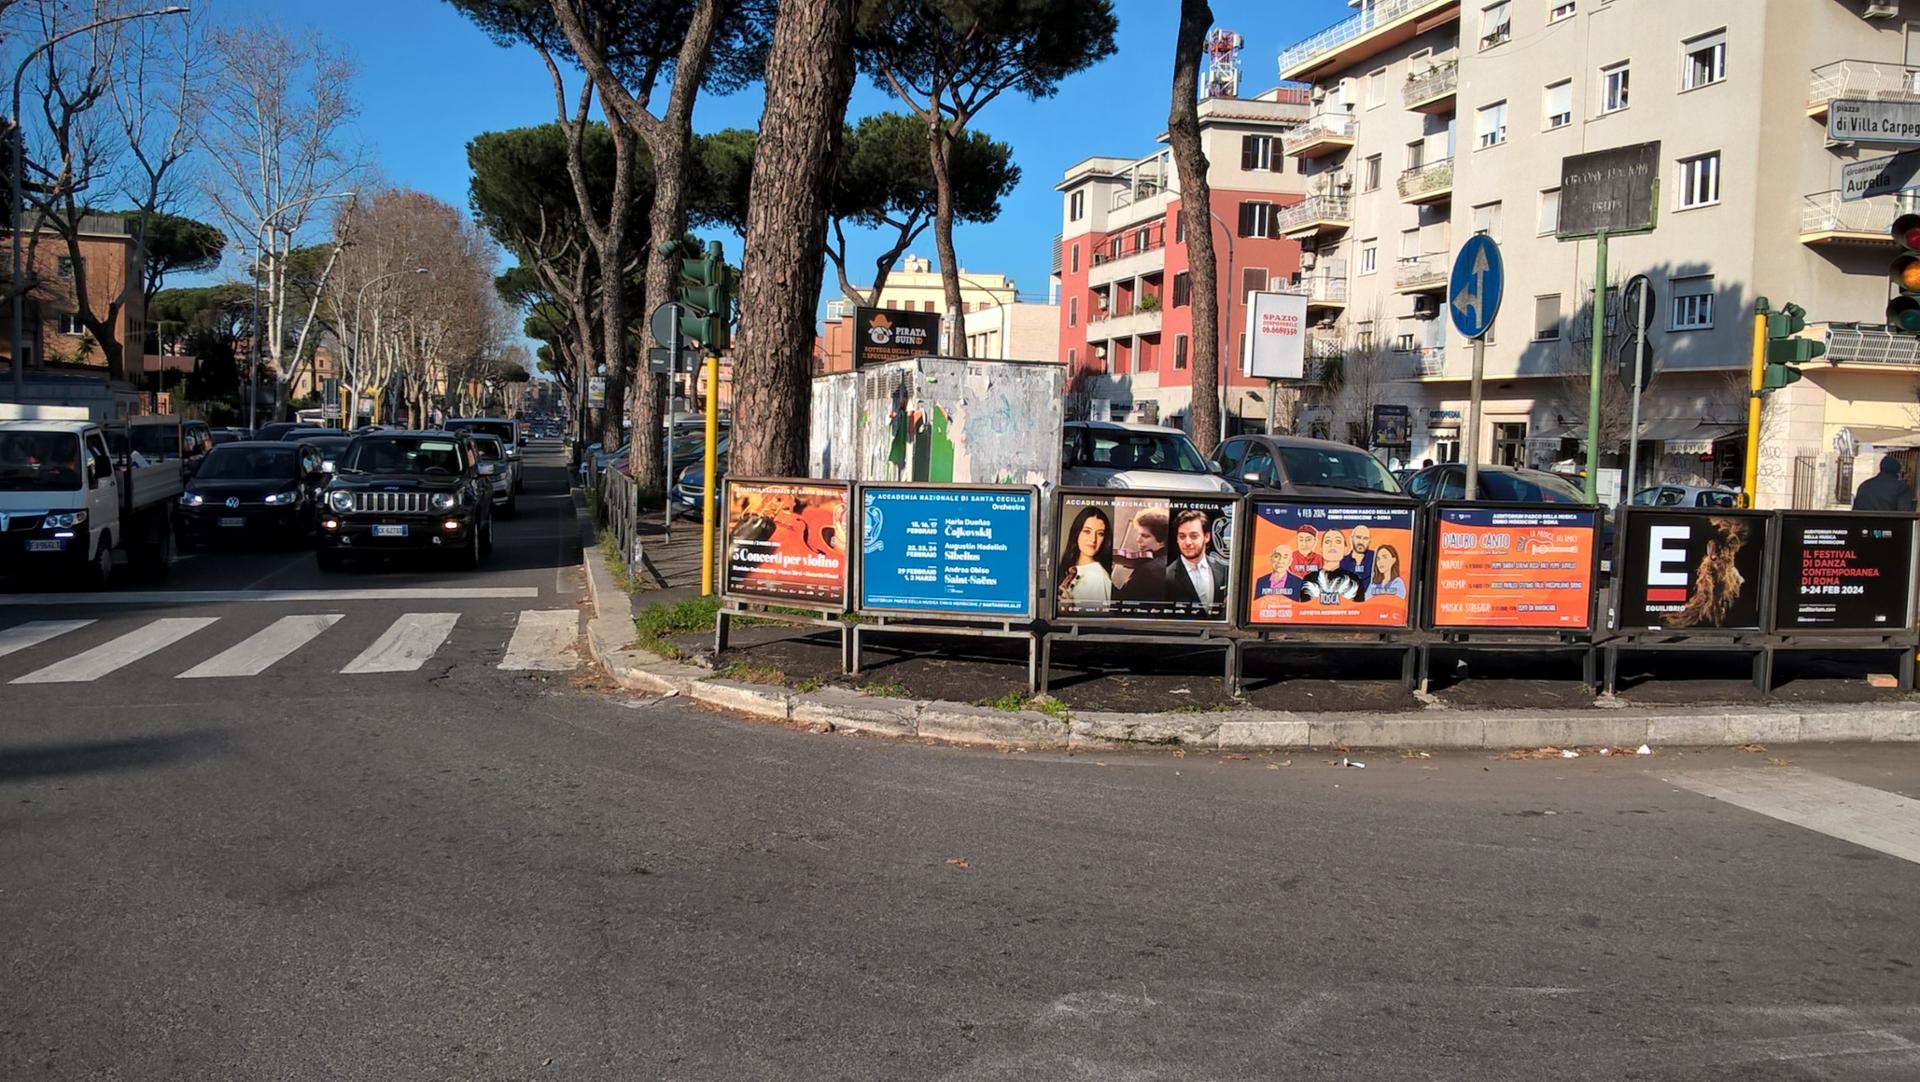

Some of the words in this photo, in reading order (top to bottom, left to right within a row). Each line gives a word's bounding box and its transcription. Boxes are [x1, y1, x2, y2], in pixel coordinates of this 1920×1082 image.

[1836, 117, 1846, 130] di
[1850, 117, 1878, 132] Villa
[1846, 174, 1890, 192] Aurelia
[896, 327, 926, 337] PIRATA
[968, 367, 982, 376] TE
[944, 526, 992, 539] Čajkovskij
[945, 542, 976, 552] Augustin
[1480, 533, 1511, 548] CANTO
[733, 548, 740, 560] 5
[740, 548, 782, 563] Concerti
[783, 555, 802, 568] per
[803, 553, 839, 568] violino
[944, 551, 980, 561] Sibelius
[1648, 526, 1690, 585] E
[944, 574, 997, 585] Saint-Saëns
[1801, 586, 1821, 594] 9-24
[1822, 586, 1840, 594] FEB
[1841, 586, 1864, 594] 2024
[1320, 592, 1340, 605] TOSCA
